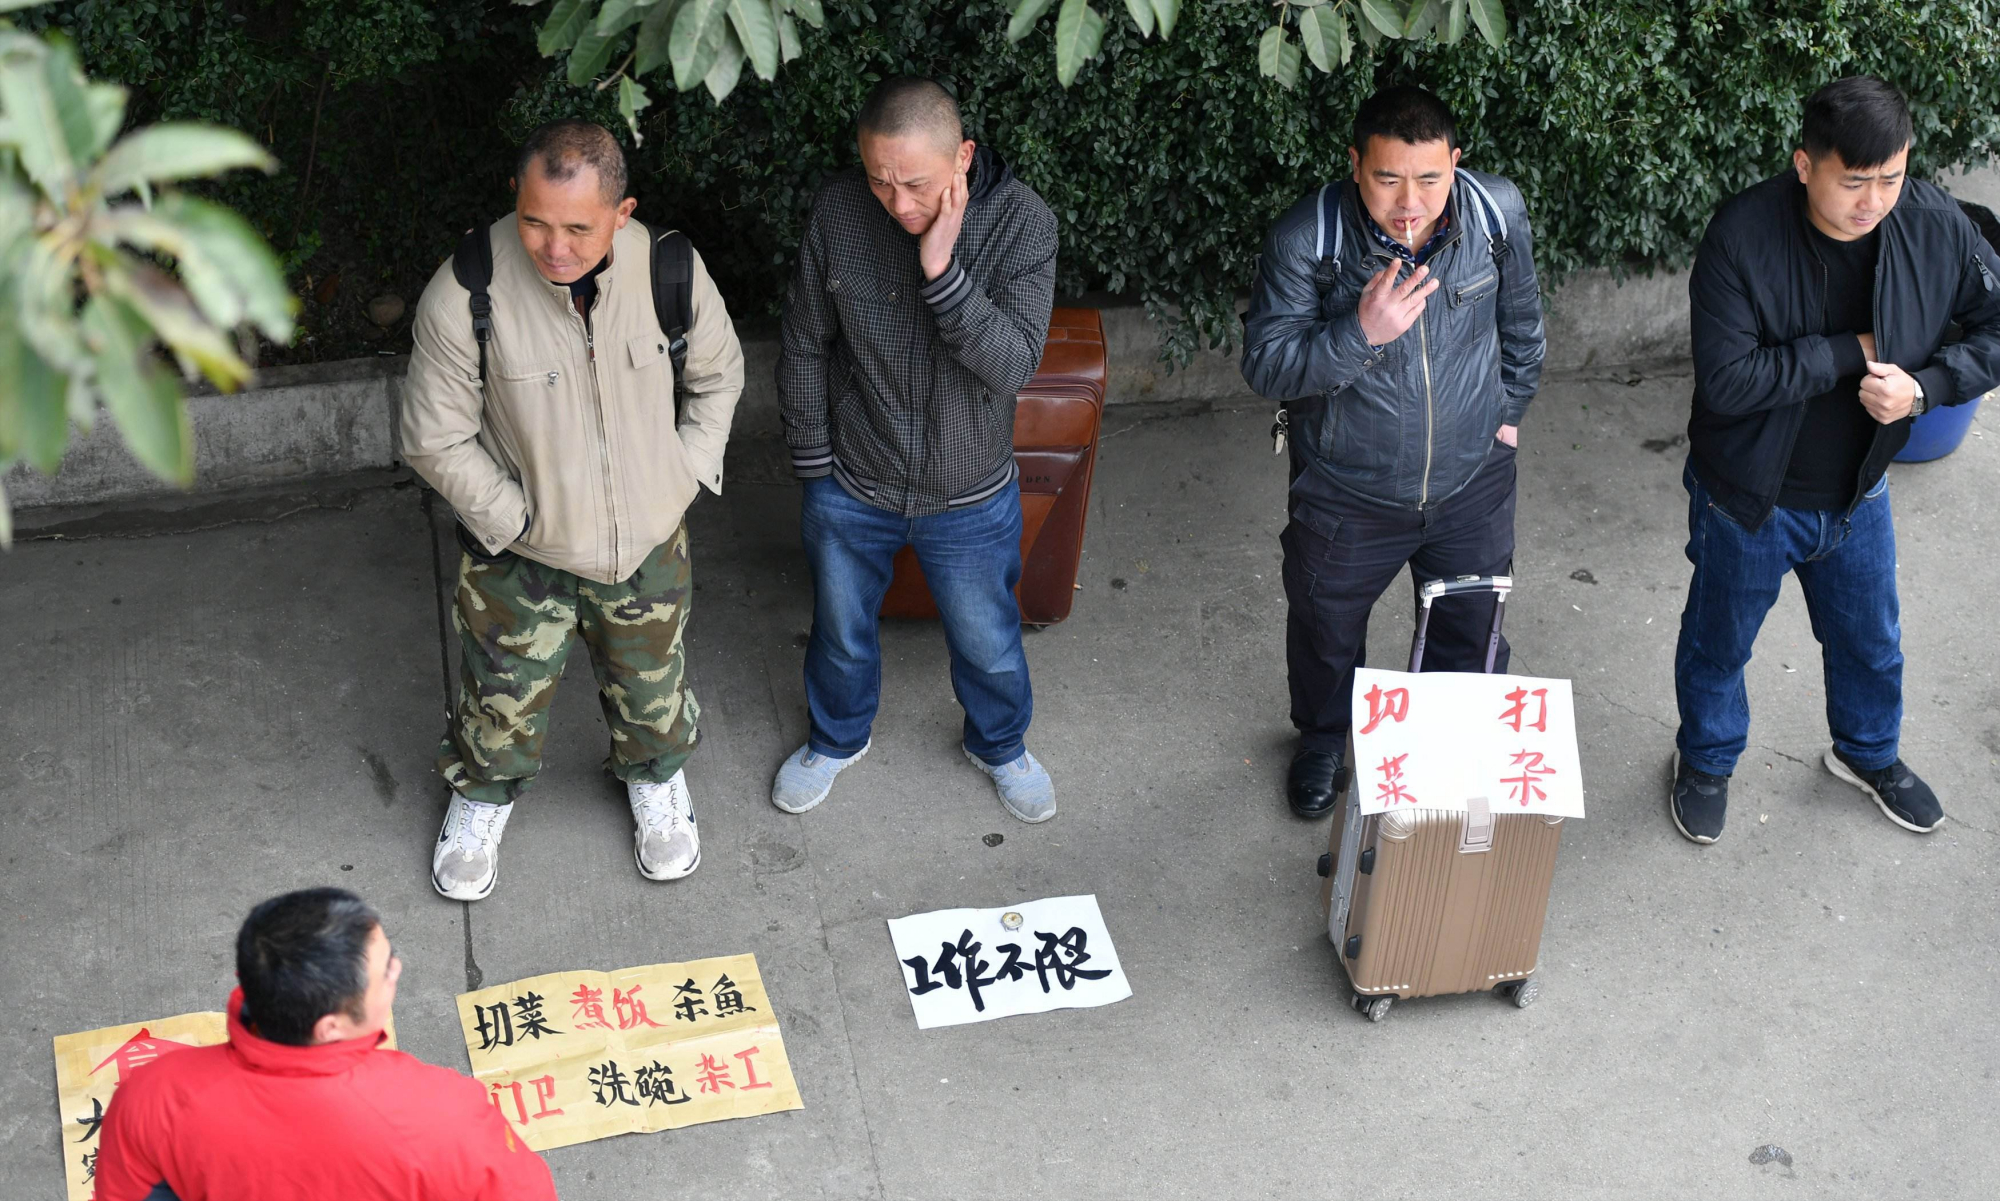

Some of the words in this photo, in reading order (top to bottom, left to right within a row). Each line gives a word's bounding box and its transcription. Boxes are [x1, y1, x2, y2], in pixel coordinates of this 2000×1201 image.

[1359, 684, 1418, 807] 切菜
[1498, 686, 1556, 806] 打杂
[902, 926, 1113, 1012] 工作不限
[474, 991, 564, 1053] 切菜
[570, 984, 670, 1031] 煮饭
[491, 1074, 564, 1126] 门卫
[588, 1060, 692, 1108] 洗碗
[695, 1046, 772, 1094] 杂工
